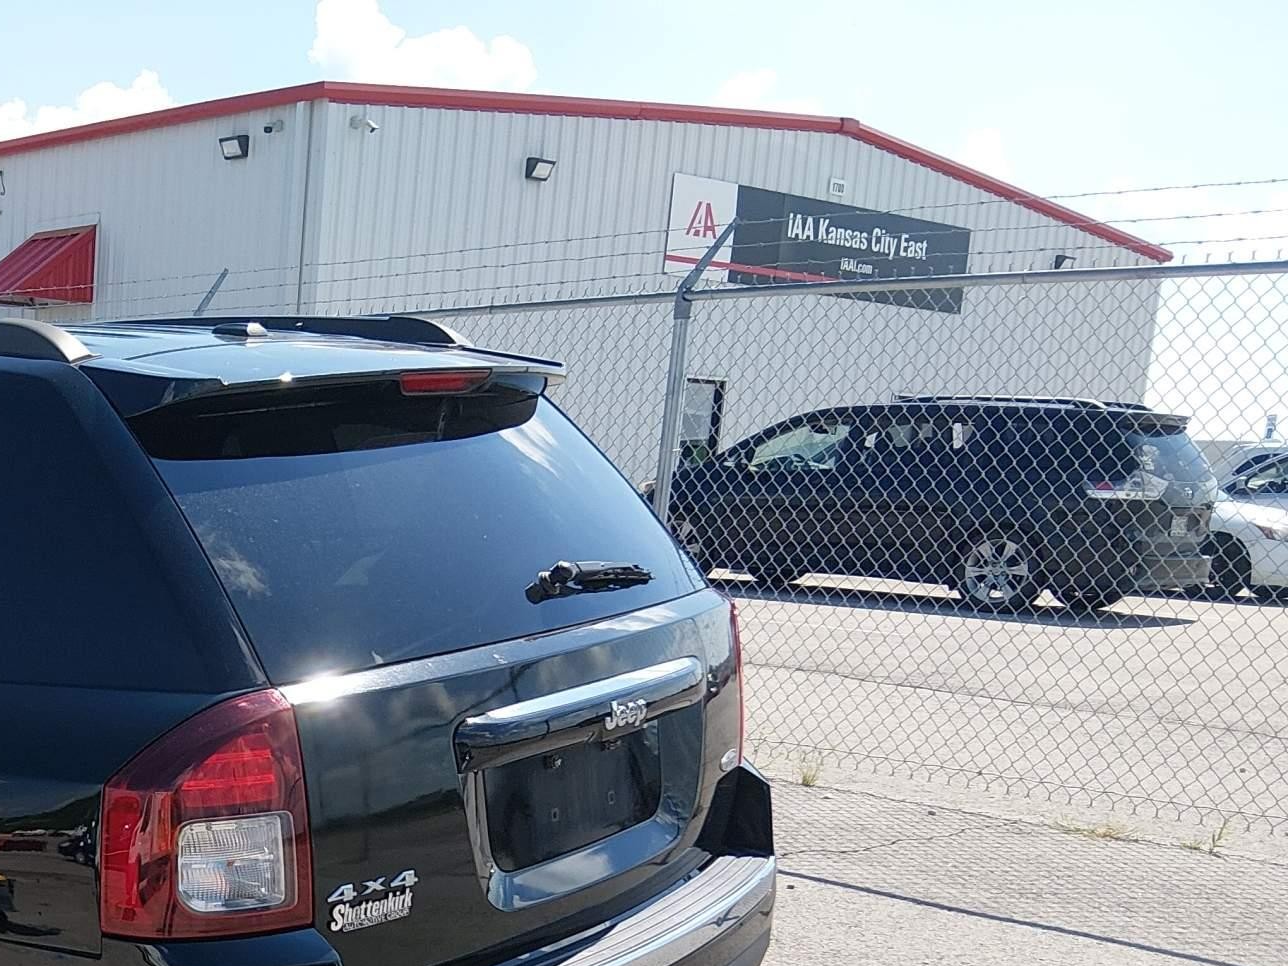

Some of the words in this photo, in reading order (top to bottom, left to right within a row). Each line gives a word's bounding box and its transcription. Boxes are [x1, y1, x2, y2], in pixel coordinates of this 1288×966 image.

[787, 212, 814, 241] IAA
[818, 218, 868, 250] Kansas
[872, 227, 898, 260] City
[899, 234, 928, 260] East
[604, 699, 647, 731] Jeep
[330, 887, 414, 932] Shottenkirk
